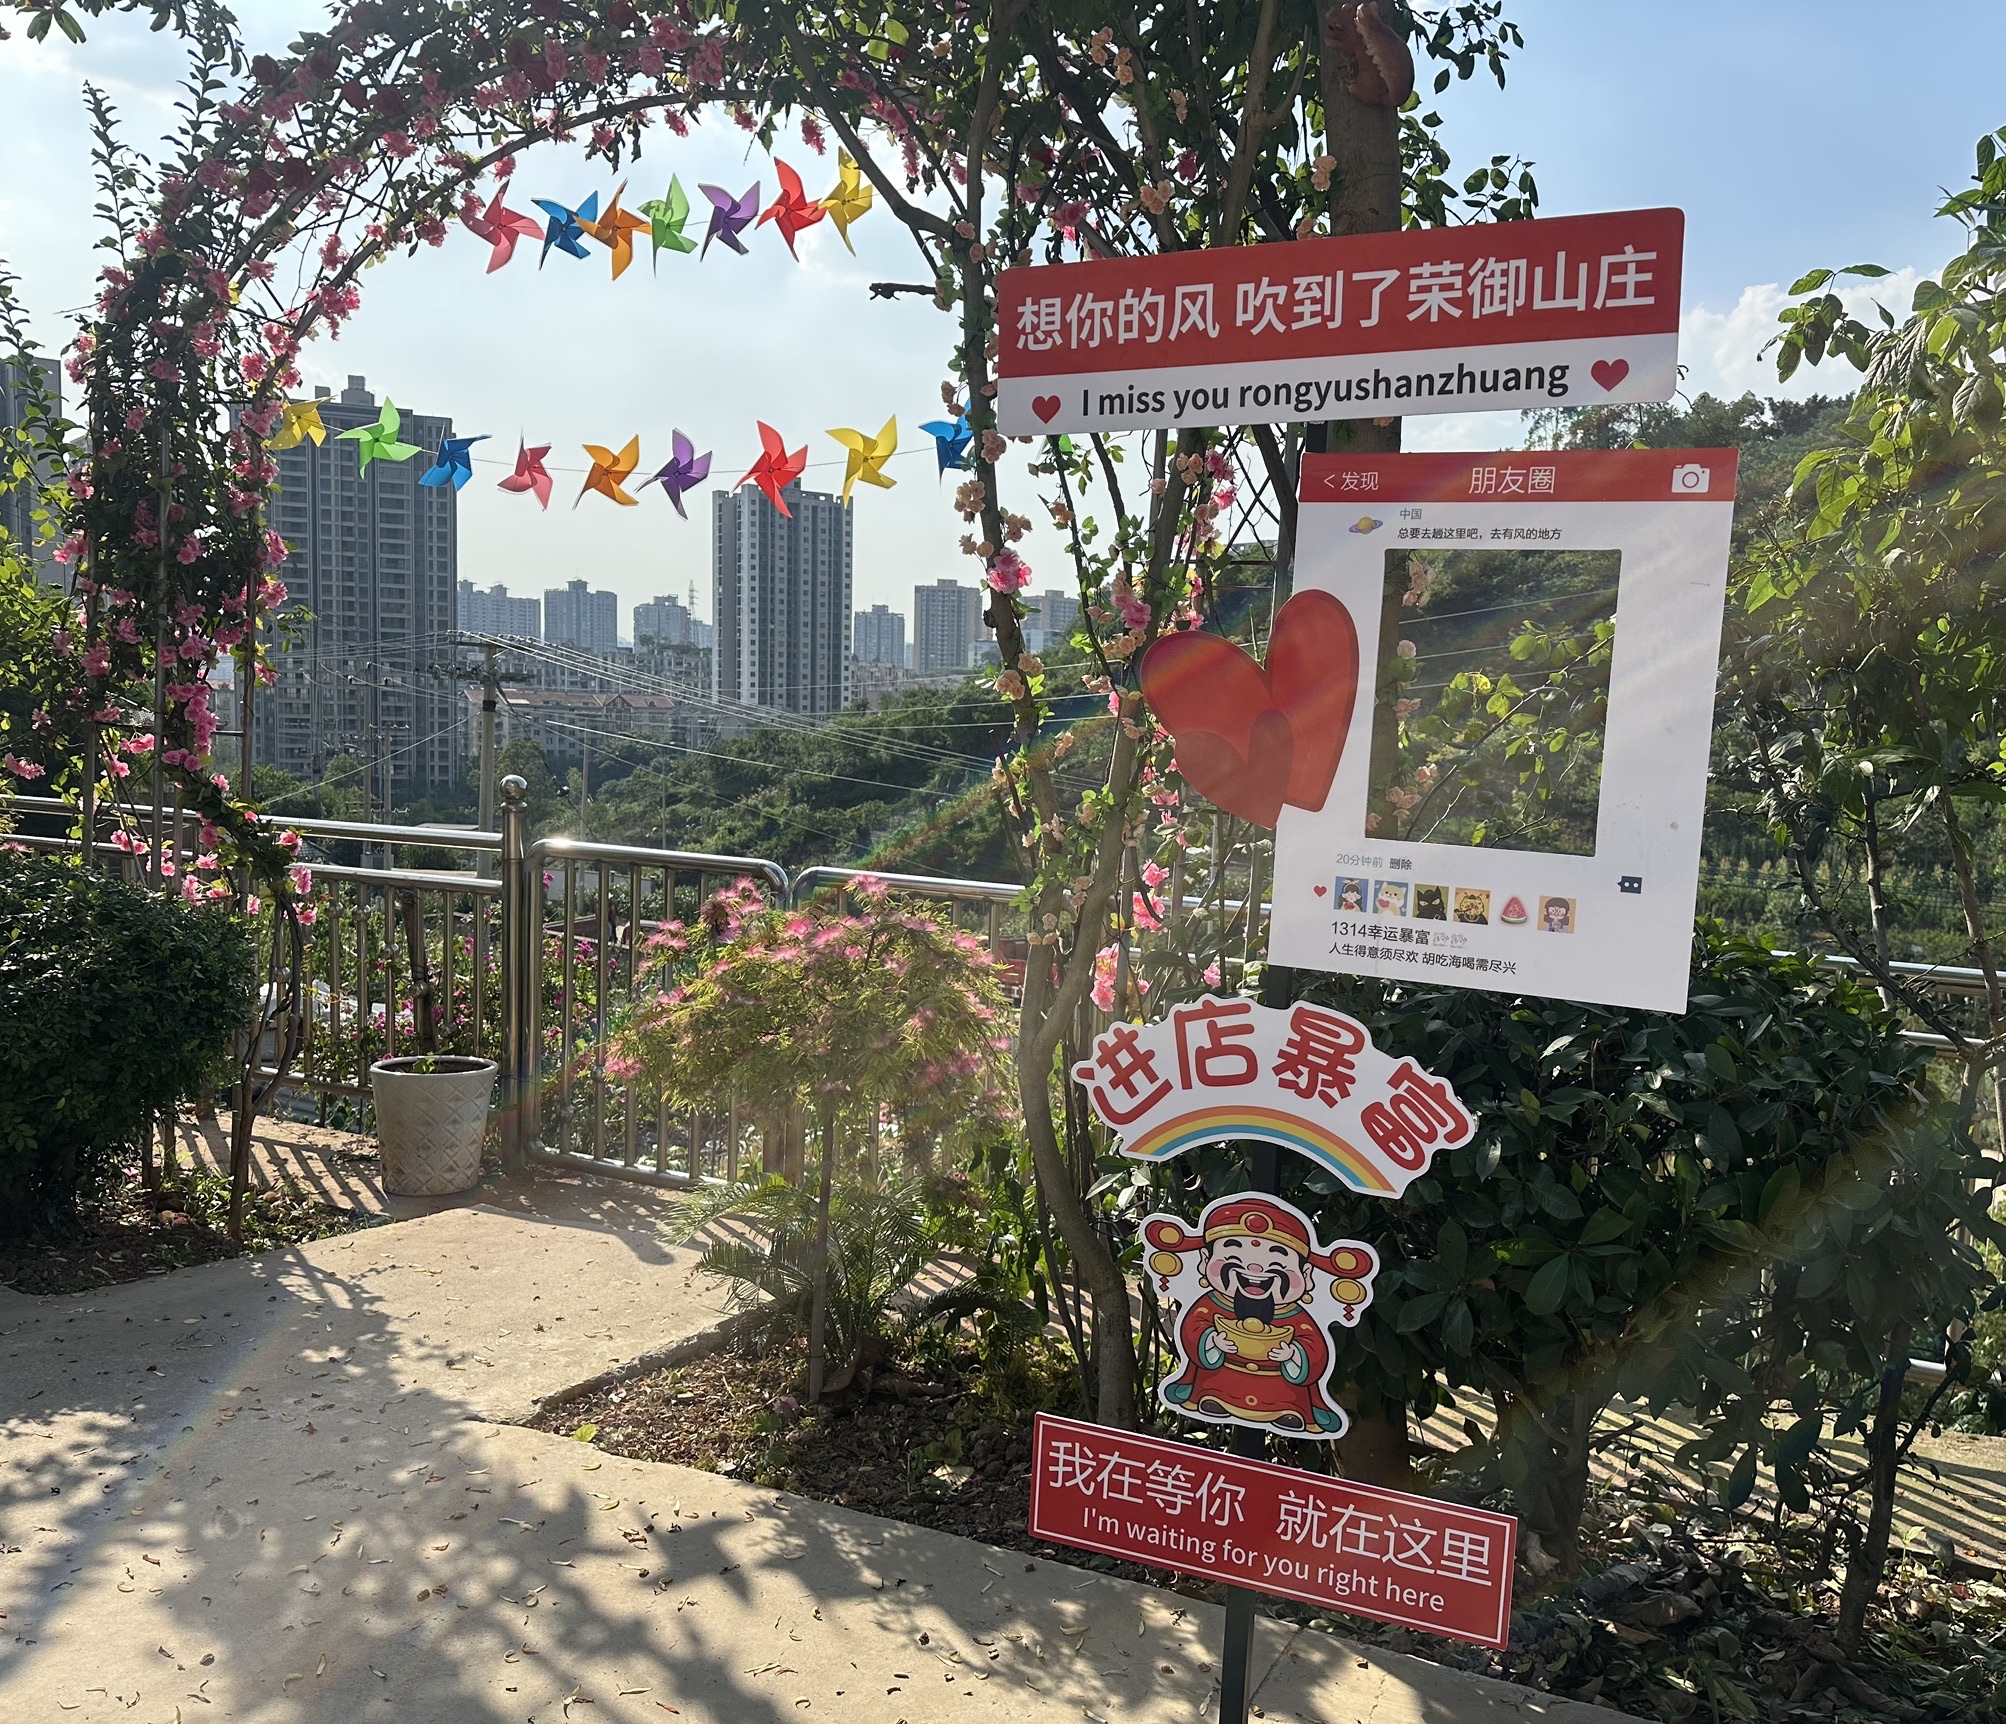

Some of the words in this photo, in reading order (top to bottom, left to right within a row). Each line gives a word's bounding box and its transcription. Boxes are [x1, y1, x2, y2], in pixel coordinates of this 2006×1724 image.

[1016, 283, 1218, 351] 想你的风
[1235, 244, 1657, 333] 吹到了荣御山庄
[1081, 390, 1089, 417] I
[1099, 380, 1166, 415] miss
[1173, 377, 1230, 417] you
[1238, 361, 1570, 413] rongyushanzhuang
[1340, 471, 1379, 492] 发现
[1469, 466, 1556, 494] 朋友圈
[1400, 508, 1422, 520] 中国
[1336, 853, 1383, 868] 20分钟前
[1389, 857, 1413, 871] 删除
[1331, 921, 1430, 945] 1314幸运暴富
[1328, 942, 1418, 963] 人生得意须尽欢
[1422, 951, 1517, 975] 胡吃海喝需尽兴
[1077, 1000, 1470, 1171] 进店暴富
[1048, 1440, 1247, 1527] 我在等你
[1275, 1489, 1493, 1587] 就在这里
[1082, 1507, 1121, 1536] I'm
[1127, 1520, 1217, 1564] waiting
[1222, 1539, 1259, 1567] for
[1262, 1552, 1310, 1579] you
[1316, 1563, 1379, 1598] right
[1385, 1576, 1446, 1613] here
